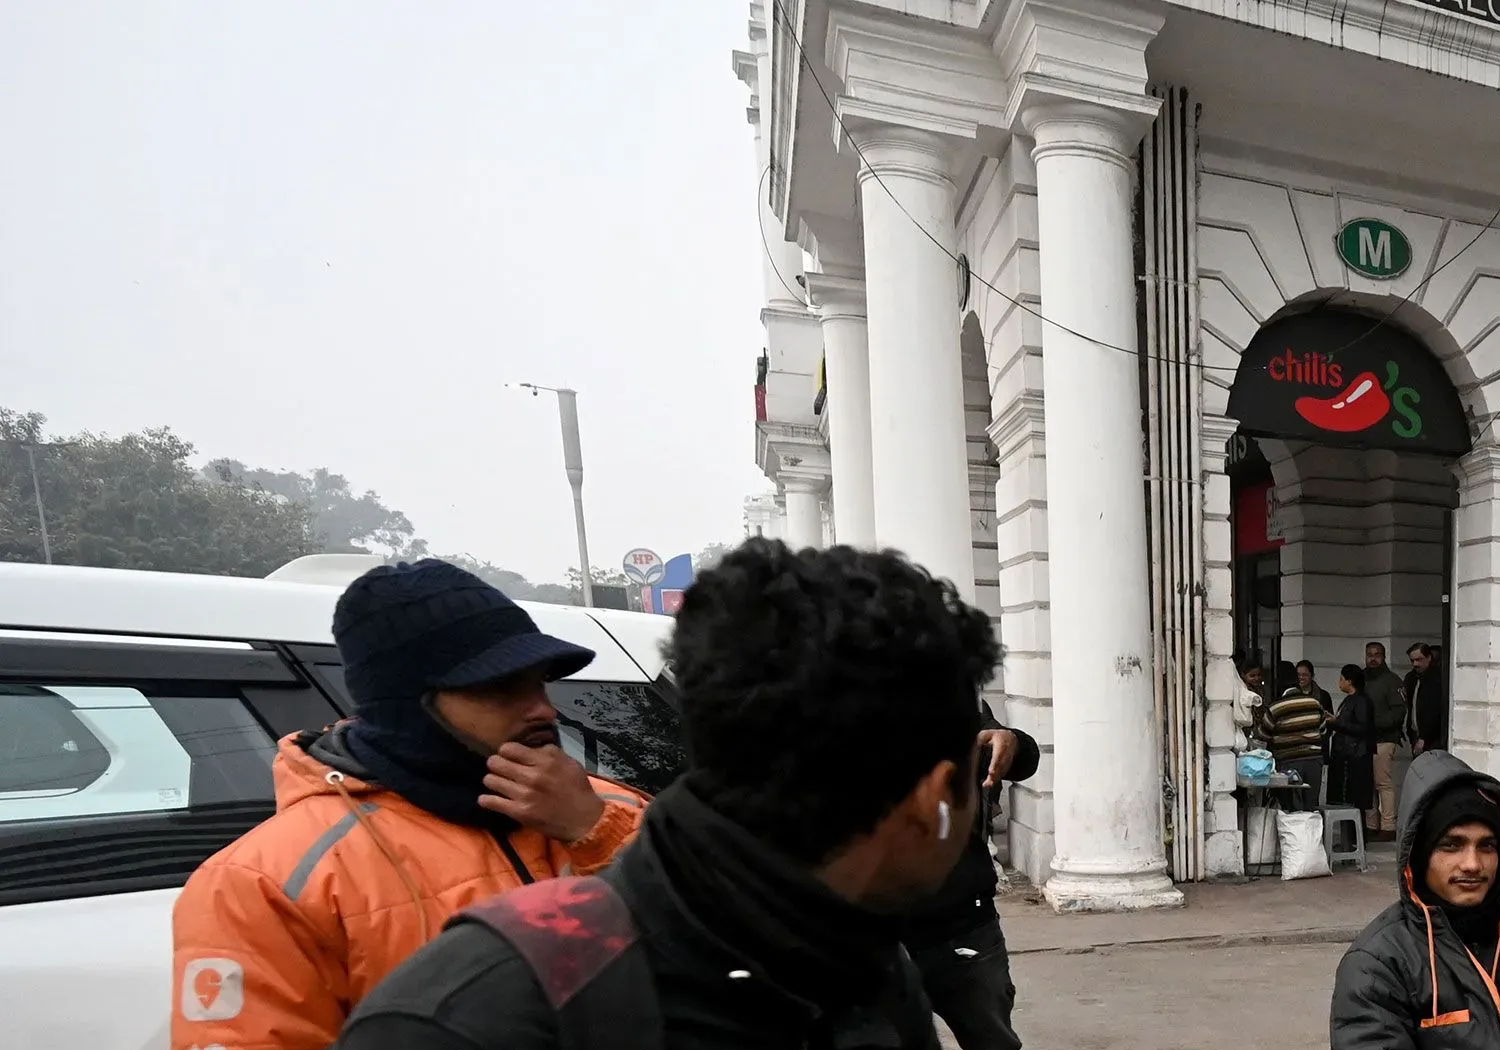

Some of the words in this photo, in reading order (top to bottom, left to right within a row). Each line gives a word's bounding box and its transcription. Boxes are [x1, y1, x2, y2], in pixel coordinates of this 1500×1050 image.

[1359, 227, 1391, 269] M
[1268, 348, 1344, 388] chili's
[632, 554, 653, 565] HP
